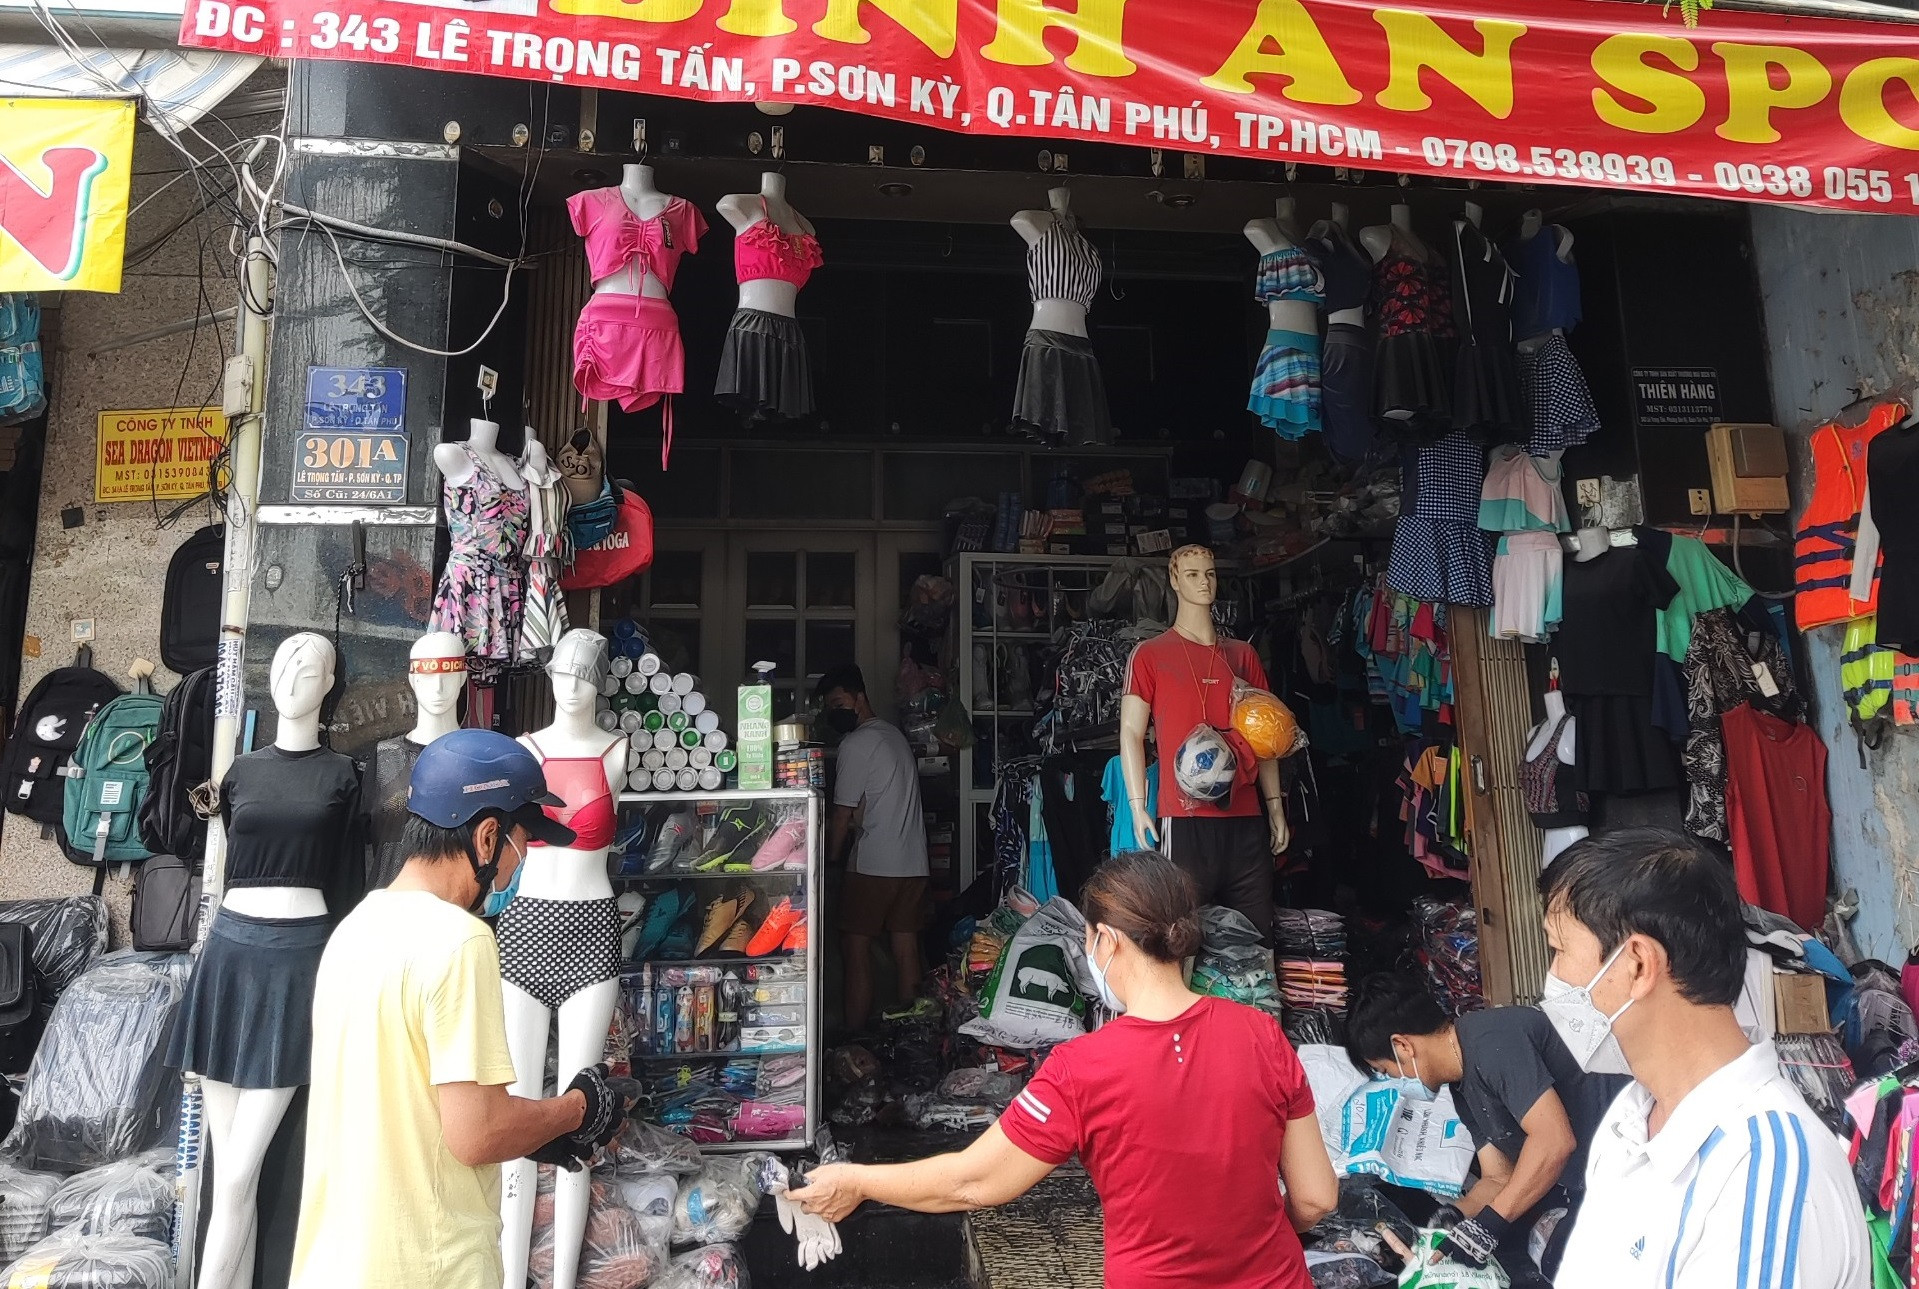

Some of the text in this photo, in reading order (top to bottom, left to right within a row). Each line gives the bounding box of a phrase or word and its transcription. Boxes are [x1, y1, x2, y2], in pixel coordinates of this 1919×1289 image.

[1200, 0, 1528, 119] AN
[195, 1, 266, 43] ĐC
[310, 12, 400, 53] 343
[416, 18, 471, 62] LÊ
[487, 29, 643, 82] TRỌNG
[656, 41, 757, 96] TẤN,
[773, 57, 896, 108] P.SƠN
[910, 75, 971, 126] KỲ,
[986, 85, 1109, 133] Q.TÂN
[1132, 101, 1221, 149] PHÚ,
[1234, 111, 1383, 161] TP.HCM
[1422, 137, 1676, 187] 0798.538939
[1713, 162, 1812, 198] 0938
[1824, 166, 1893, 203] 055
[327, 374, 387, 399] 343
[1638, 380, 1716, 399] THIÊN HÀNG
[1646, 405, 1667, 413] MST:
[116, 416, 213, 433] CÔNG TY TNHH
[104, 435, 223, 466] SEA DRAGON VIETNAM
[303, 437, 398, 469] 301A
[115, 469, 140, 481] MST:
[297, 470, 306, 483] LÊ
[307, 471, 329, 485] TRỌNG
[331, 470, 345, 483] TẤN
[304, 489, 321, 499] Số
[352, 489, 393, 499] 24/6A1
